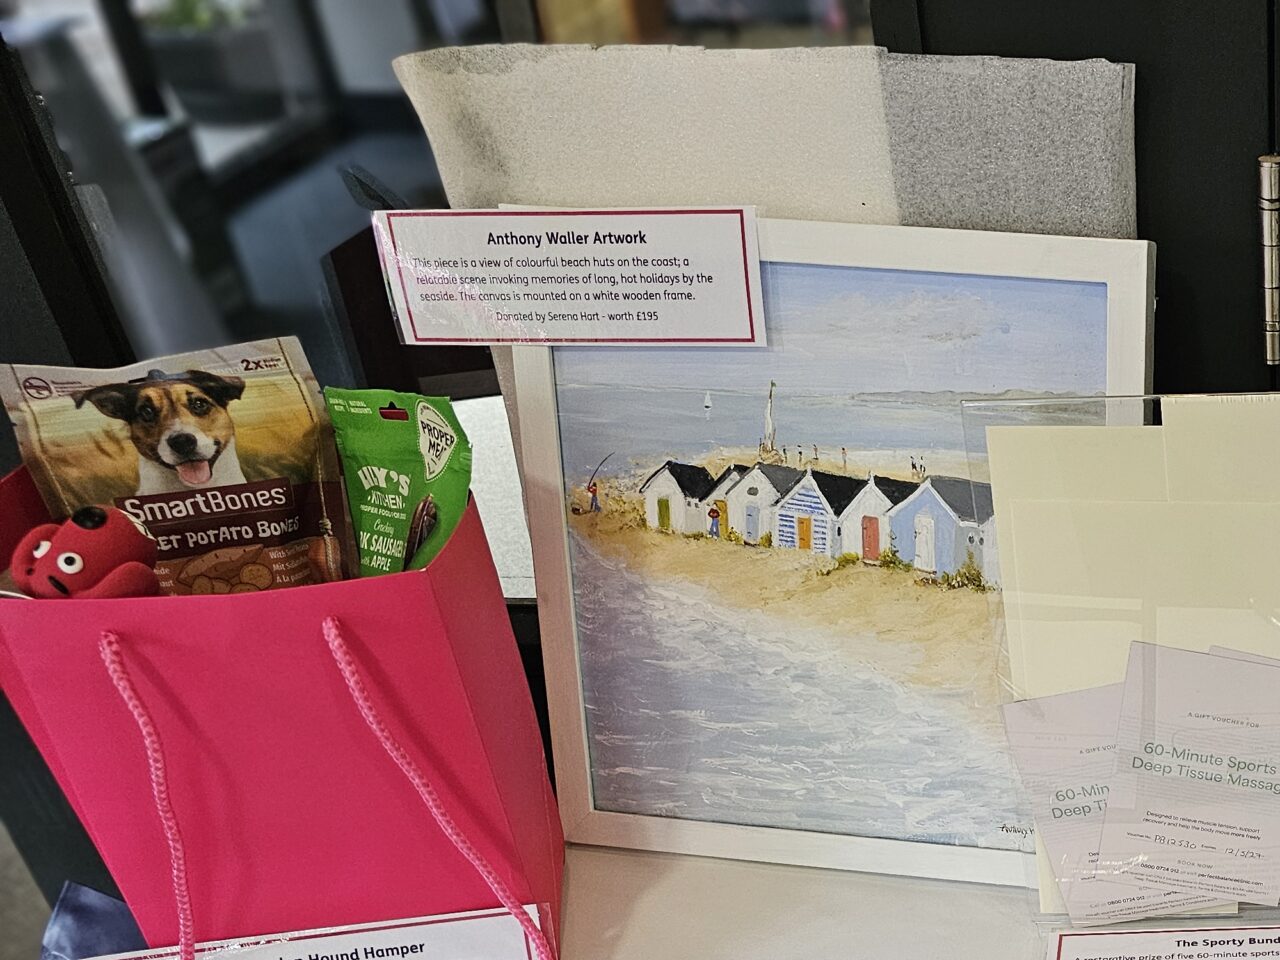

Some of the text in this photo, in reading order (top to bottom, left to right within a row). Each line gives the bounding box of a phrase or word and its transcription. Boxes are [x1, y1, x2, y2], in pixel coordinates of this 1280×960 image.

[487, 230, 647, 248] Anthony Waller Artwork
[412, 256, 689, 270] This piece is a view of colourful beach huts on the coast; a
[420, 420, 455, 446] PROPER
[125, 487, 287, 523] SmartBones
[185, 524, 253, 548] POTATO
[257, 516, 299, 538] BONES
[370, 555, 391, 571] APPLE
[1144, 742, 1224, 766] 60-Minute
[1227, 756, 1277, 775] Sports
[1132, 756, 1172, 776] Deep
[1177, 764, 1223, 783] Tissue
[1056, 784, 1110, 801] 60-Min
[1052, 805, 1091, 818] Deep
[363, 943, 425, 959] Hamper
[1176, 939, 1198, 947] The
[1202, 938, 1245, 948] Sporty
[1196, 951, 1248, 959] 60-minute
[1250, 950, 1280, 958] sports
